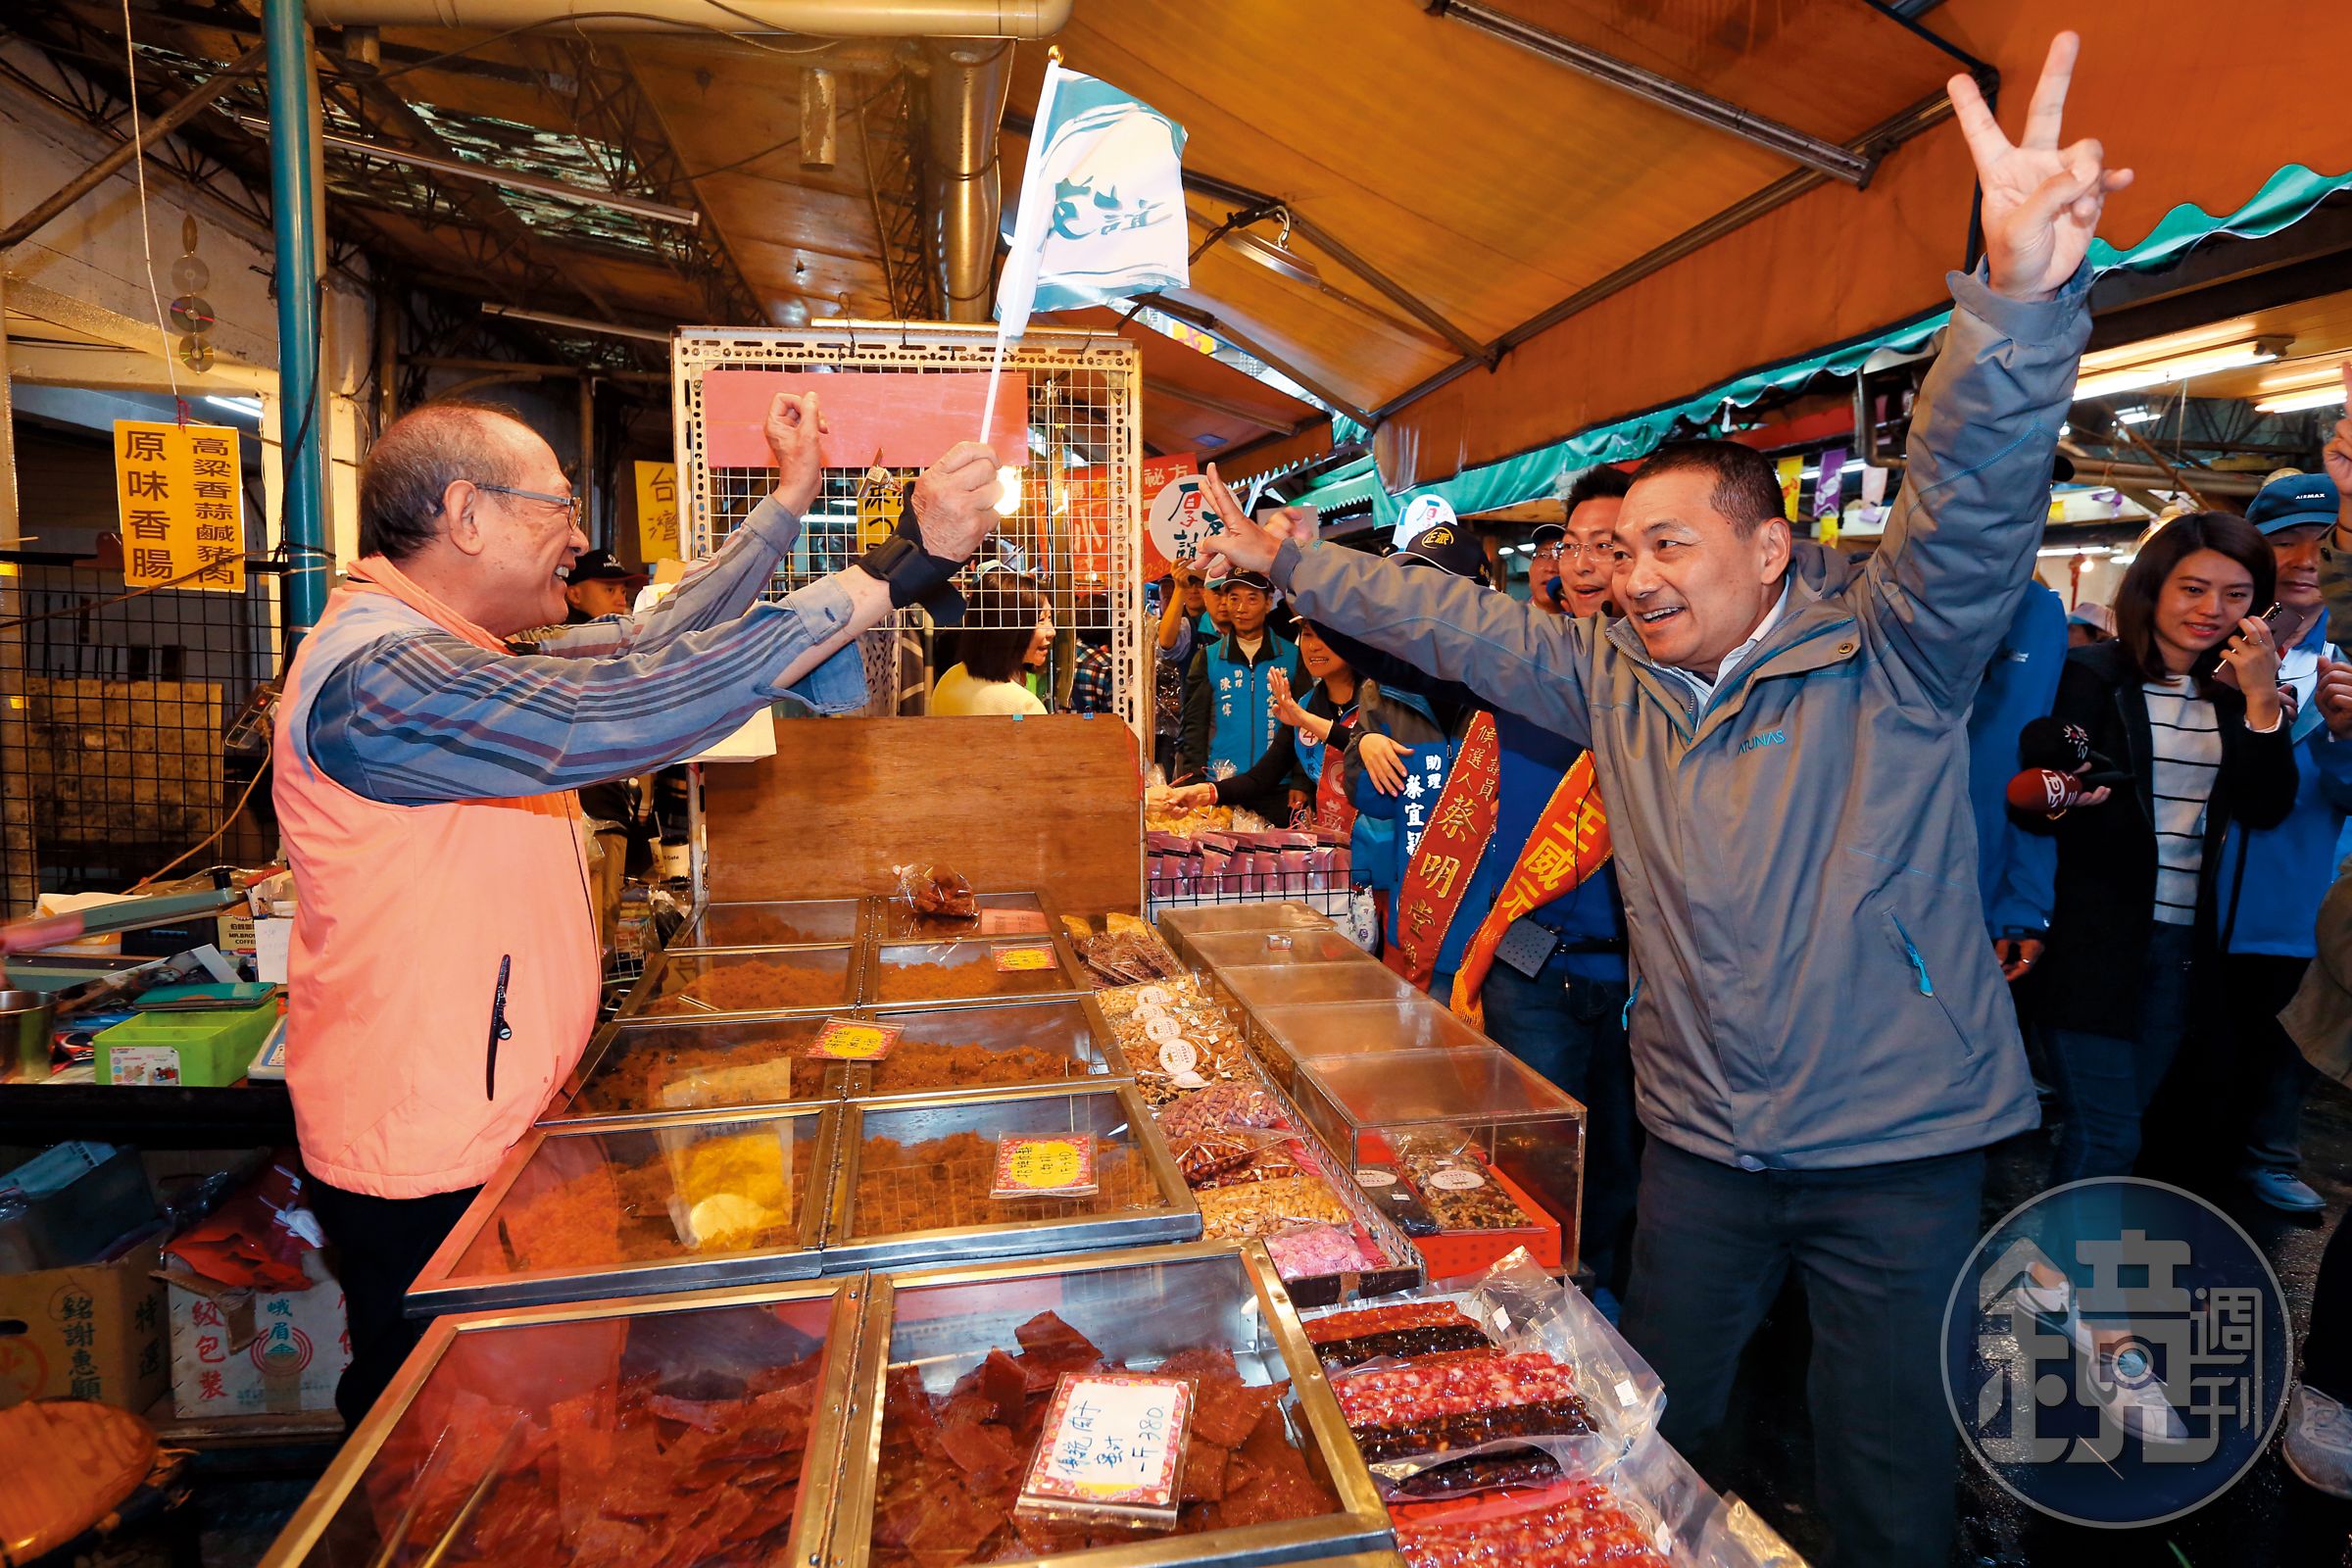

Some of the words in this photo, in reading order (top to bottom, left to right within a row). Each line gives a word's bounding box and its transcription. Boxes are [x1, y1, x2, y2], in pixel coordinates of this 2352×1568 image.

[124, 429, 173, 580] 原味香腸
[1425, 754, 1442, 790] 助理
[1454, 724, 1497, 792] 候選人
[1407, 794, 1478, 941] 蔡明堂
[1501, 796, 1608, 922] 王威元
[267, 1298, 293, 1342] 峨眉
